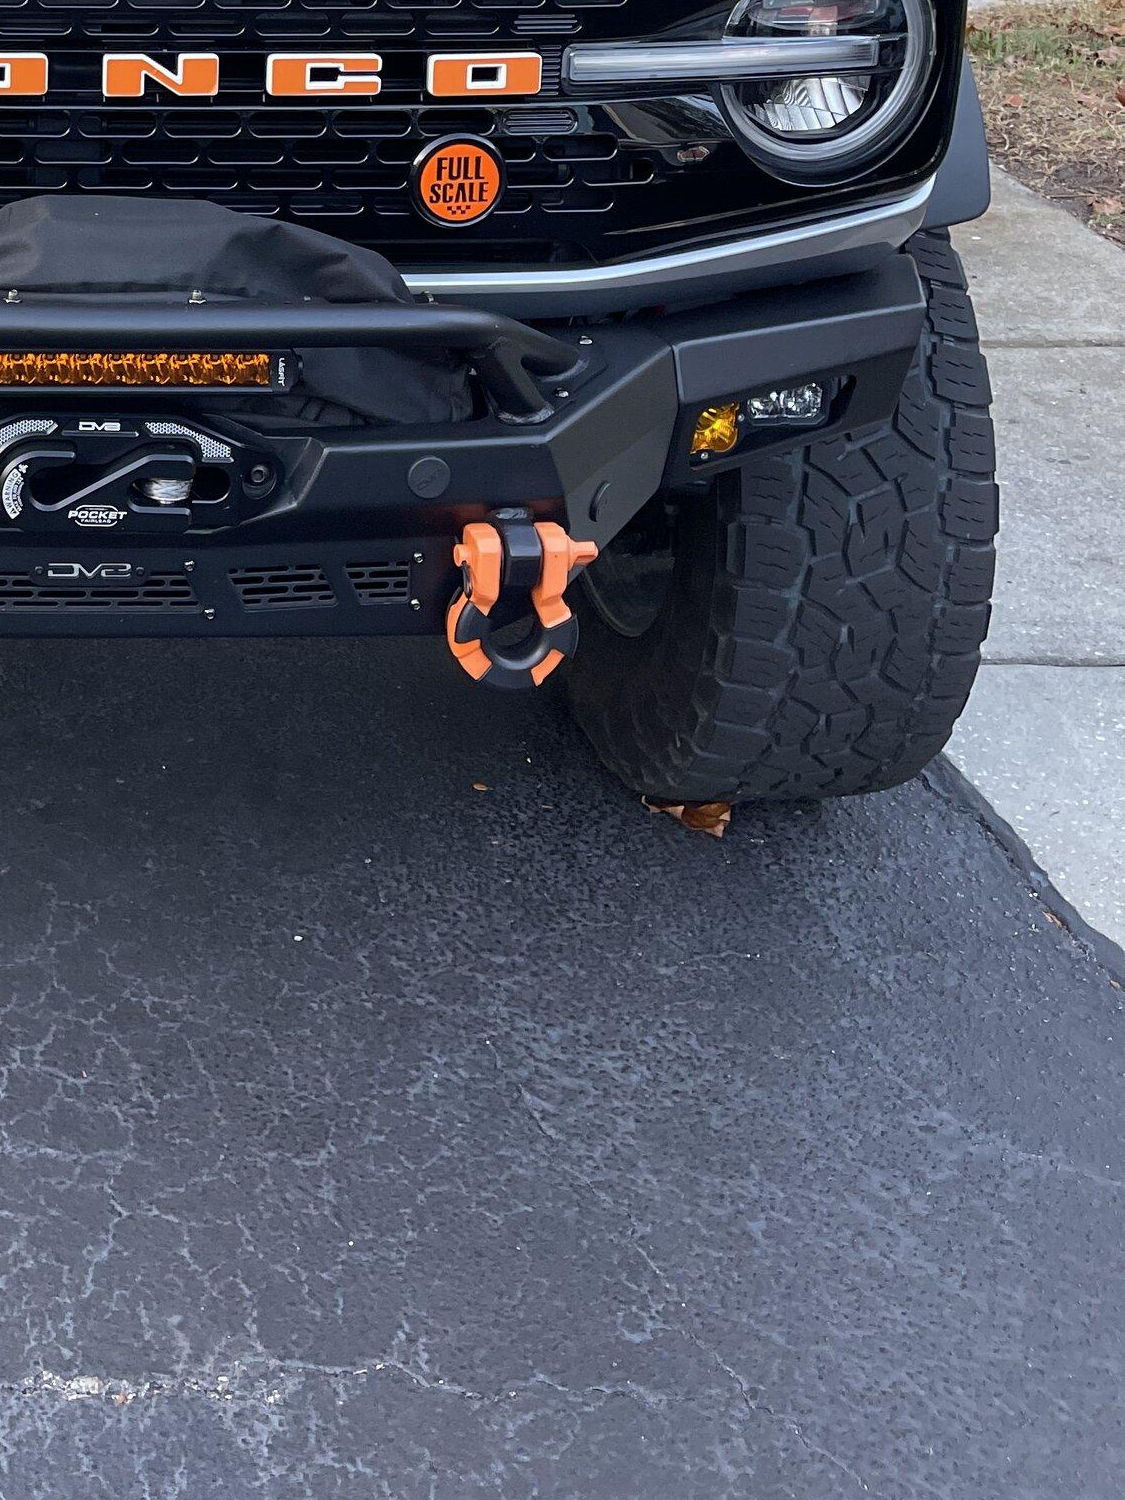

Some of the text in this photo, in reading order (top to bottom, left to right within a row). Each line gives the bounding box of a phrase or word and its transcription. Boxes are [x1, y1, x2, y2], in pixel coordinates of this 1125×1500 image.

[436, 155, 485, 182] FULL
[429, 182, 489, 204] SCALE
[4, 470, 19, 509] WARNING
[67, 510, 128, 520] POCKET
